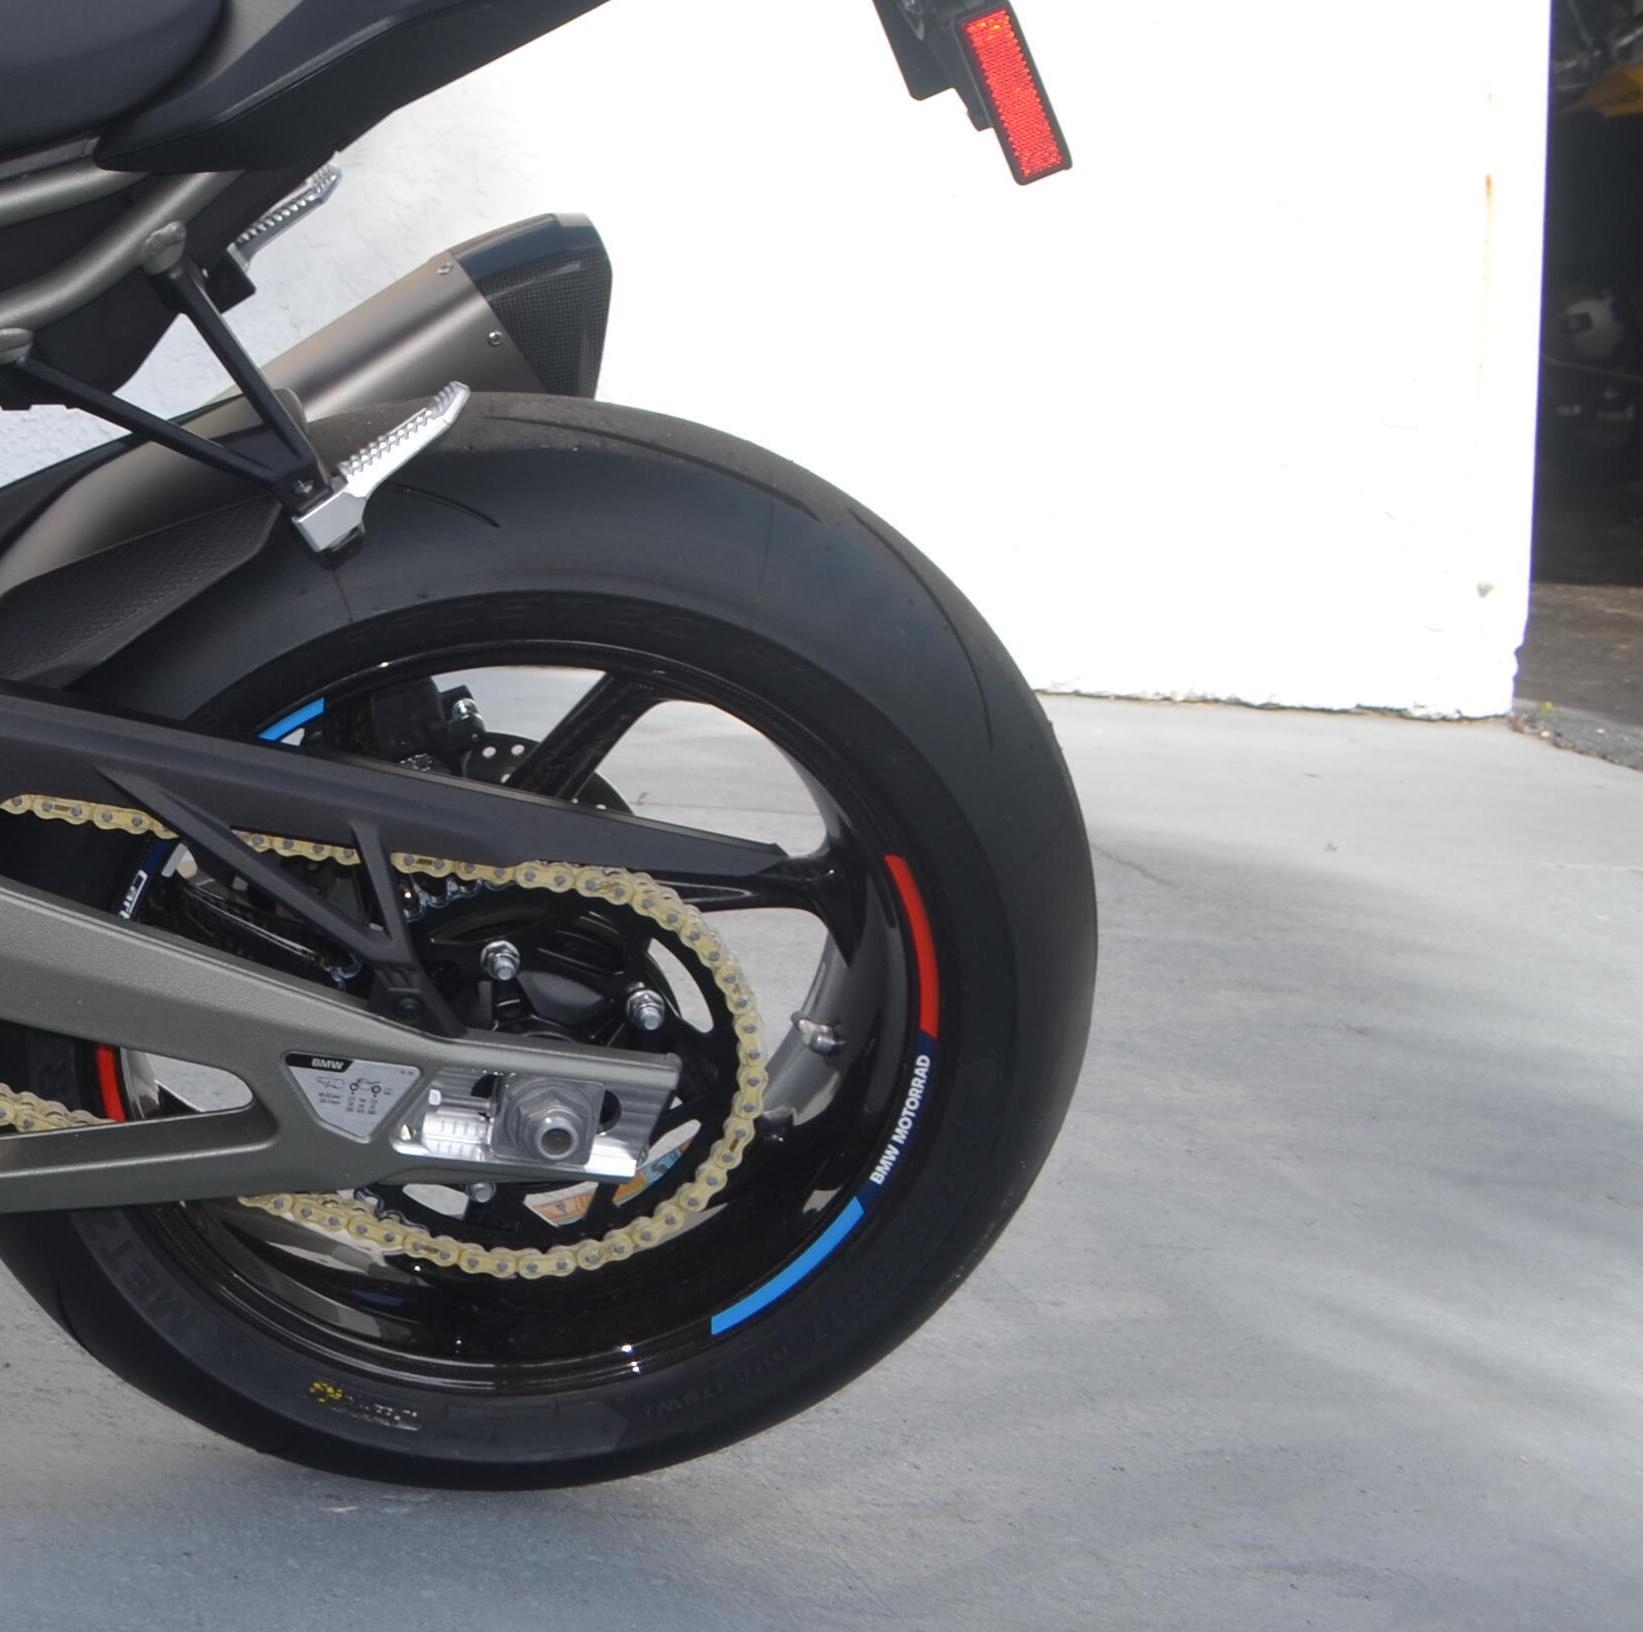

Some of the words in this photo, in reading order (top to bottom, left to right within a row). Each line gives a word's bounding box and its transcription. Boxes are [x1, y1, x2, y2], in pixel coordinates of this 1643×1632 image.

[311, 1057, 345, 1070] BMW
[869, 1143, 900, 1186] BMW
[891, 1054, 931, 1145] MOTORRAD
